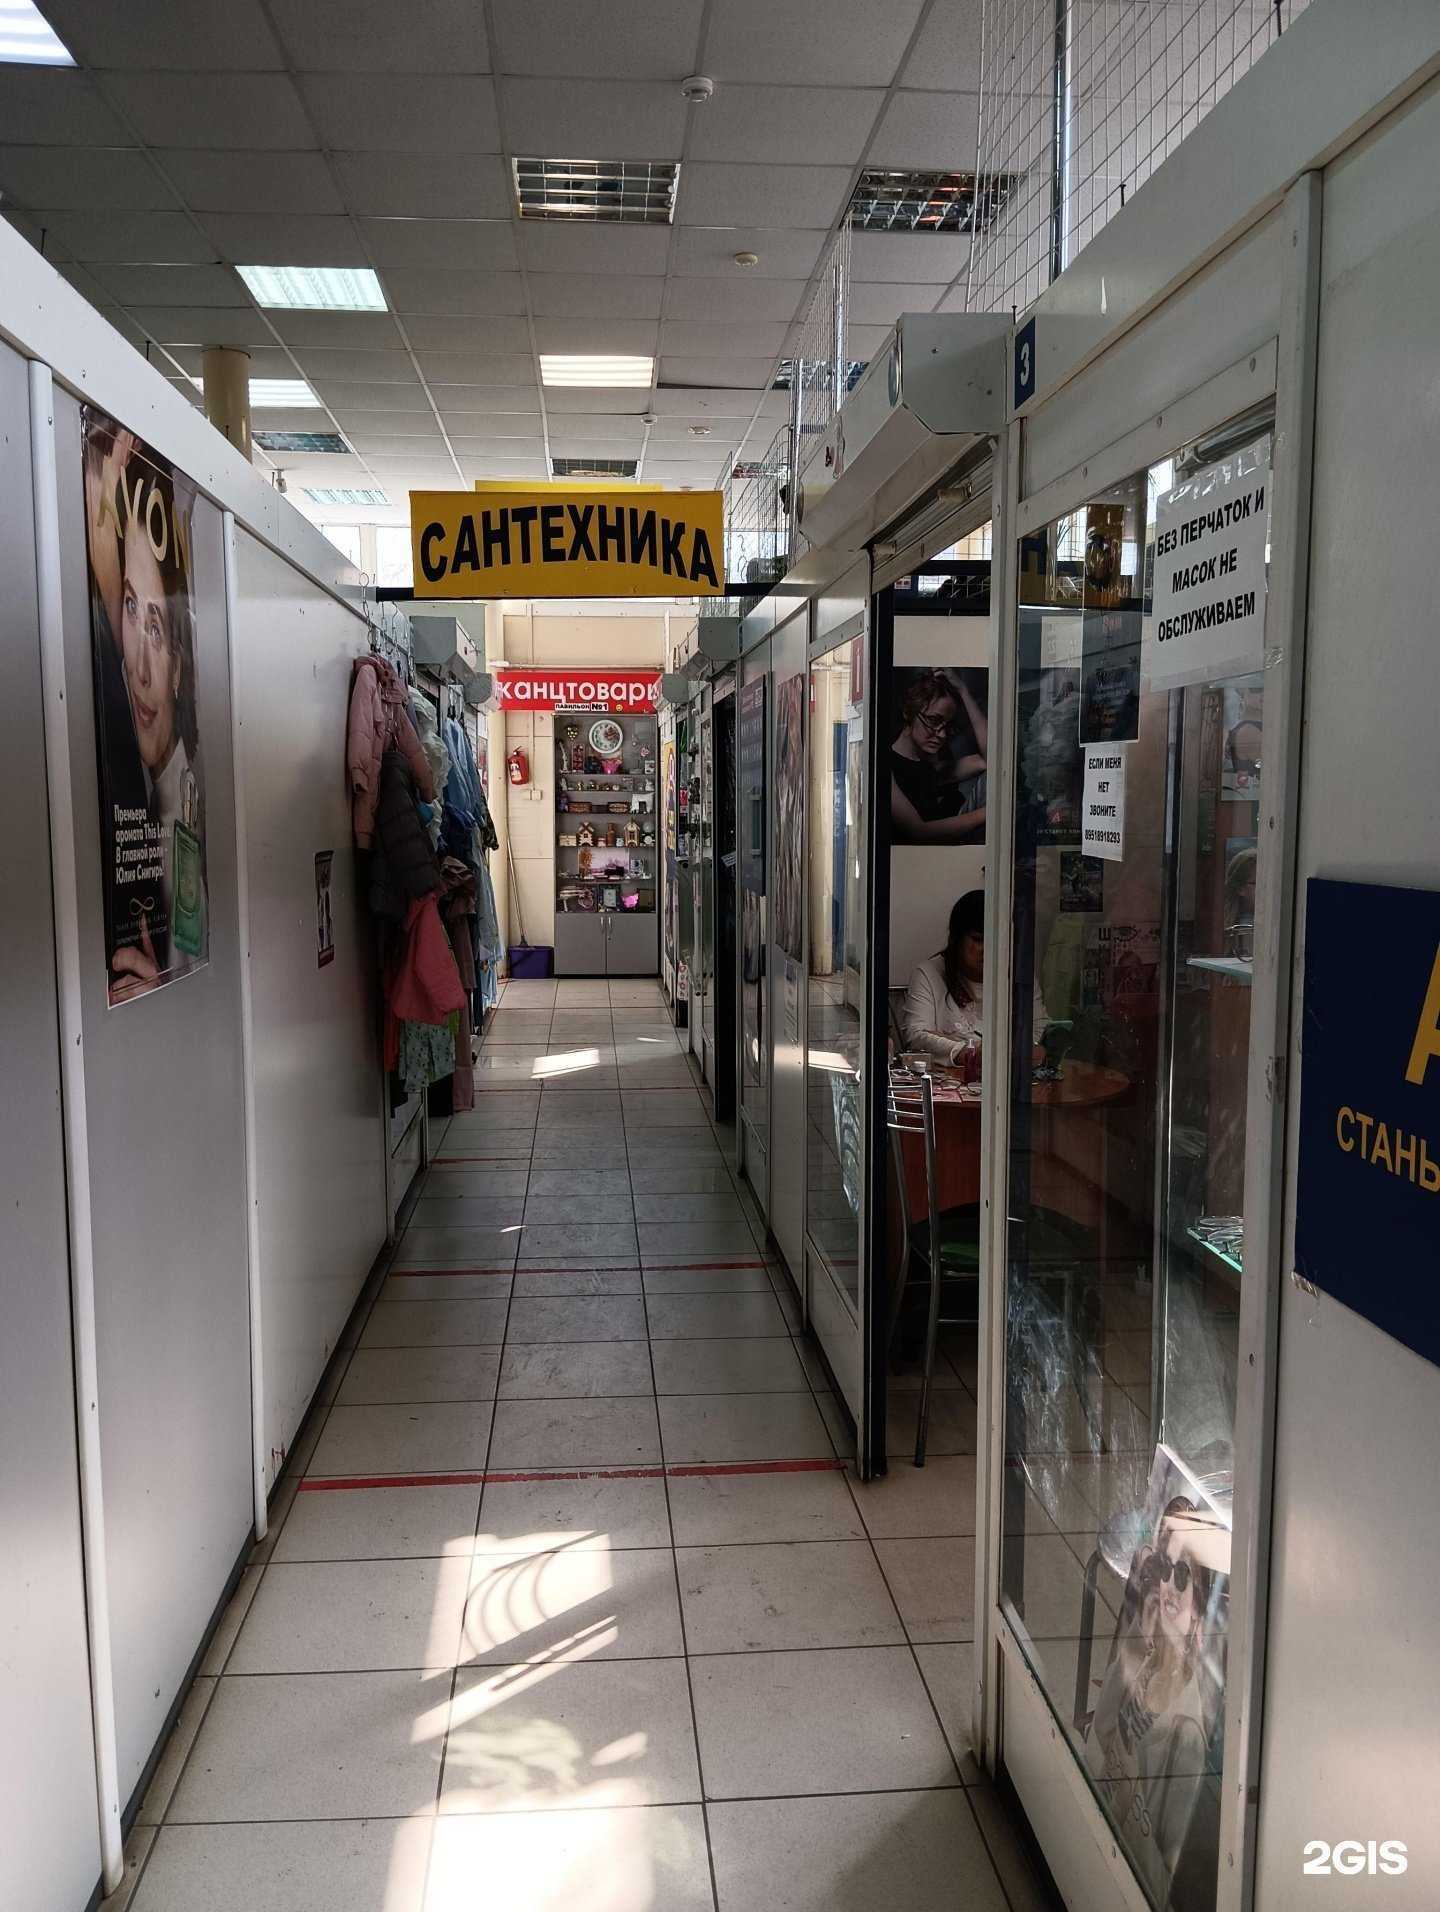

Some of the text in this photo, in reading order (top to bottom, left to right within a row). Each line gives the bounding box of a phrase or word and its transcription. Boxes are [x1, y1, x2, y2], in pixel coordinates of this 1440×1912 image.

[1020, 341, 1030, 386] 3
[97, 456, 191, 575] AVON
[1157, 486, 1264, 557] БЕЗ ПЕРЧАТОК И
[420, 504, 719, 588] САНТЕХНИКА
[1172, 548, 1237, 594] МАСОК НЕ
[1158, 592, 1255, 642] ОБСЛУЖИВАЕМ
[1088, 757, 1122, 770] ЕСЛИ МЕНЯ
[1098, 782, 1109, 793] НЕТ
[114, 804, 147, 826] Премьера
[1089, 804, 1117, 817] ЗВОНИТЕ
[115, 828, 144, 848] аромата
[144, 822, 157, 839] This
[115, 846, 121, 864] В
[122, 843, 148, 863] главной
[115, 866, 136, 886] Юлия
[1336, 1106, 1440, 1193] СТАНЬ
